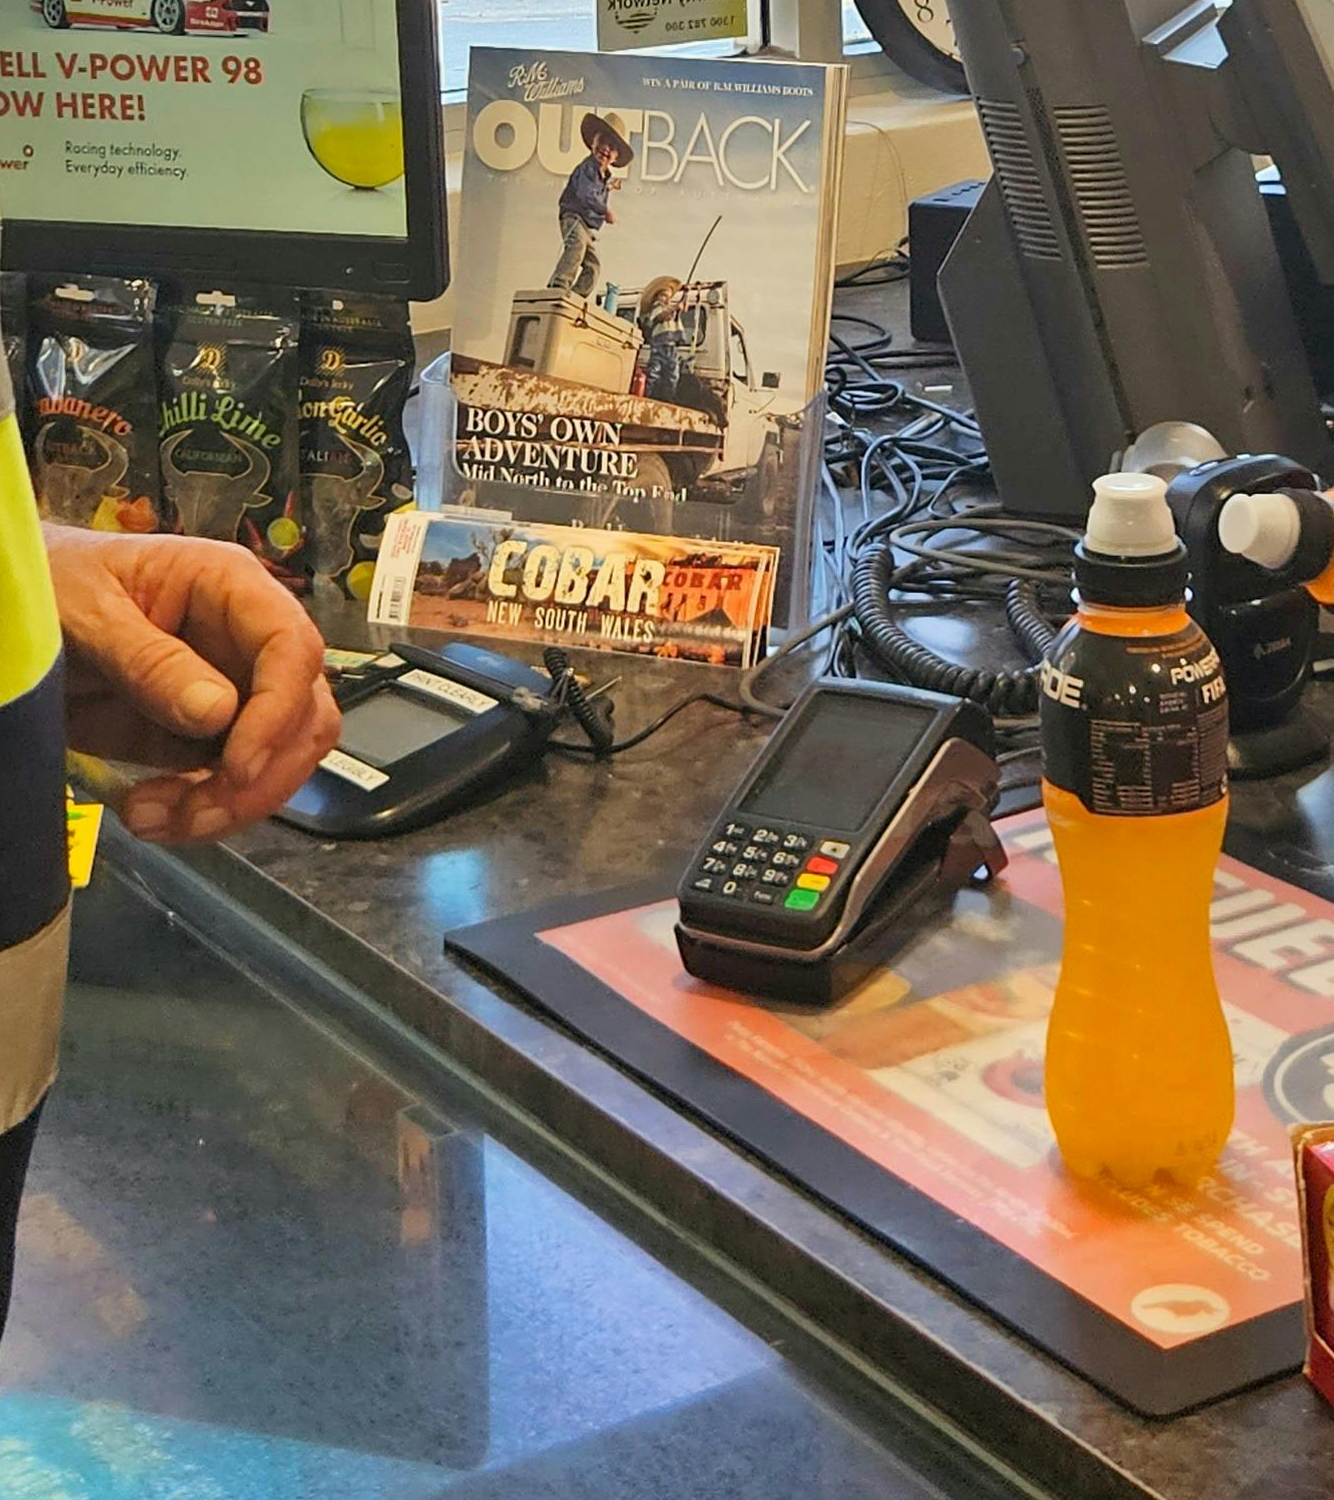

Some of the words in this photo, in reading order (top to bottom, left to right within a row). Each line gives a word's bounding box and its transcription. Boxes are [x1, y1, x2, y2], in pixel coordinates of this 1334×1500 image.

[55, 52, 211, 83] V-POWER
[222, 55, 263, 85] 98
[642, 77, 662, 89] WIN
[672, 79, 695, 90] PAIR
[695, 80, 711, 91] OF
[783, 84, 813, 97] BOOTS
[55, 92, 146, 121] HERE!
[524, 76, 584, 102] Williams
[65, 141, 106, 157] Racing
[110, 143, 182, 161] technology.
[473, 100, 812, 194] OUTBACK
[65, 160, 124, 178] Everyday
[39, 396, 132, 436] abanero
[159, 391, 207, 438] hilli
[211, 394, 282, 448] Lime
[327, 396, 388, 447] Garlic
[465, 407, 543, 438] BOYS'
[550, 416, 623, 446] OWN
[463, 435, 639, 478] ADVENTURE
[462, 463, 495, 481] Mid
[499, 466, 550, 487] North
[556, 475, 574, 489] to
[579, 476, 608, 492] the
[612, 479, 646, 503] Top
[487, 539, 667, 616] COBAR
[487, 599, 520, 627] NEW
[534, 604, 588, 633] SOUTH
[600, 613, 656, 643] WALES
[1170, 646, 1220, 685] POWER
